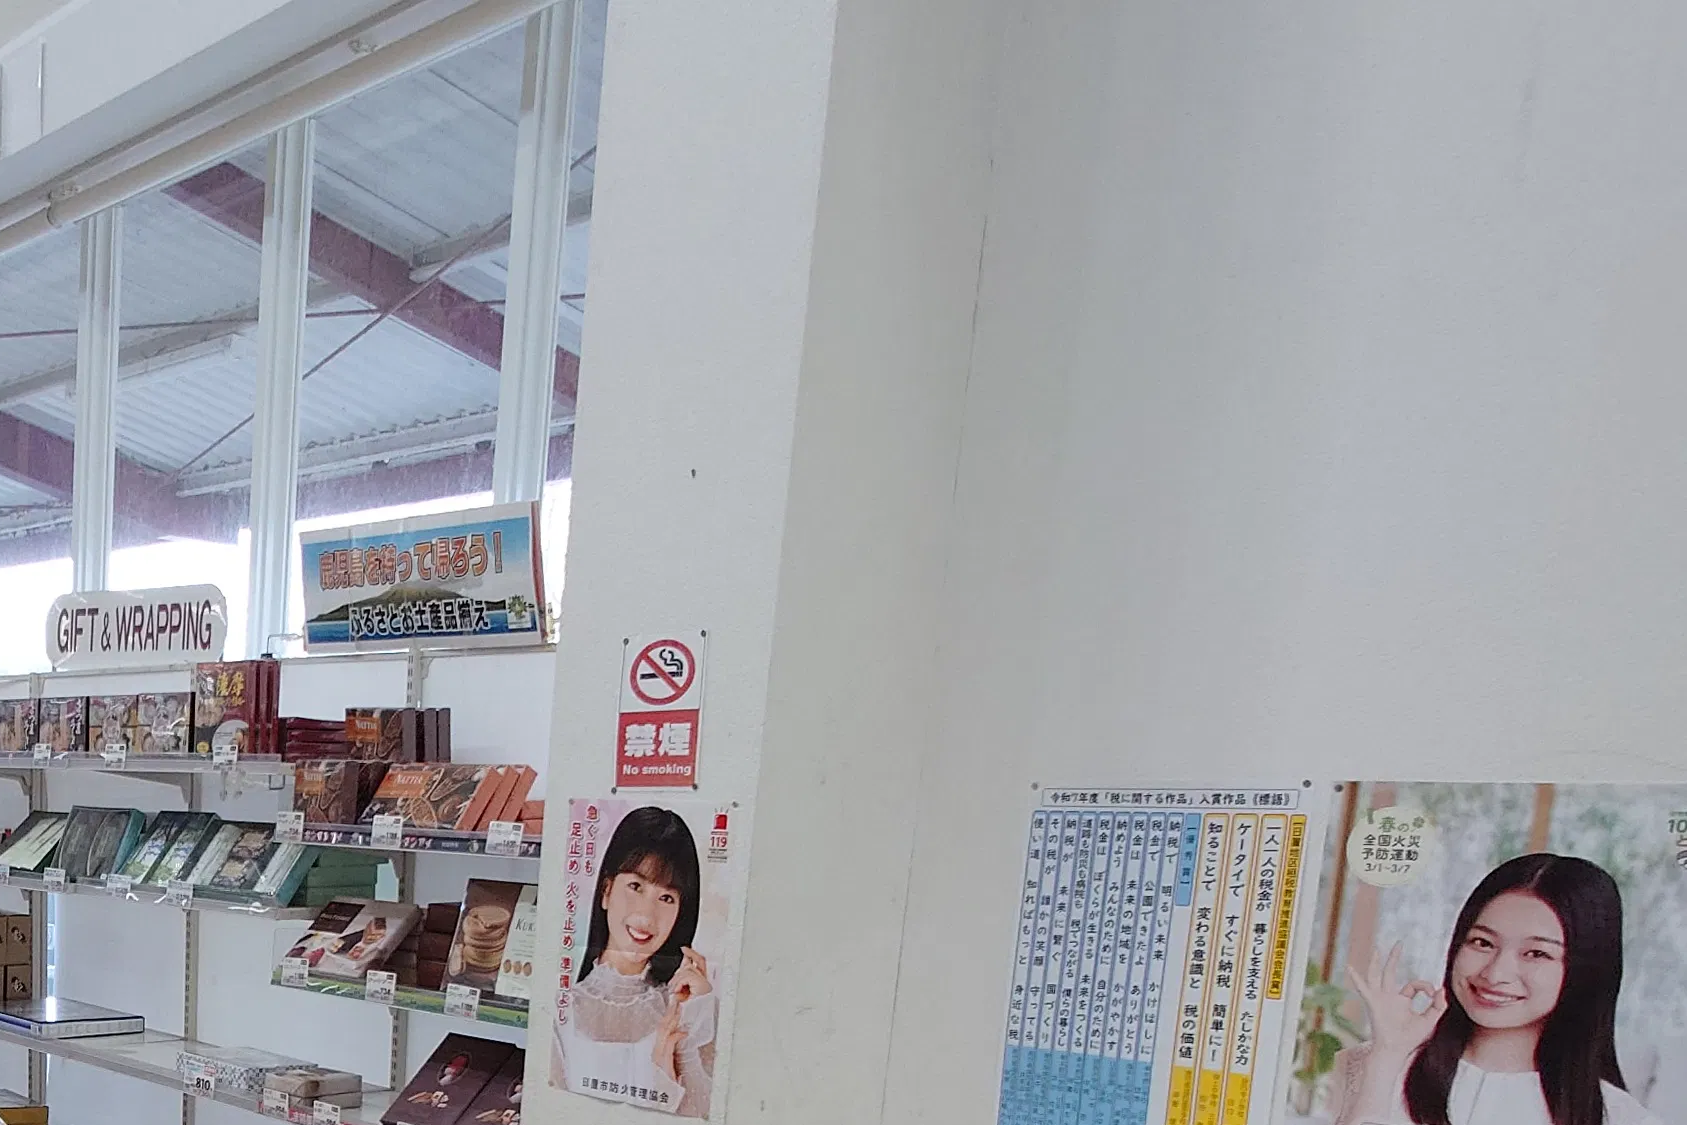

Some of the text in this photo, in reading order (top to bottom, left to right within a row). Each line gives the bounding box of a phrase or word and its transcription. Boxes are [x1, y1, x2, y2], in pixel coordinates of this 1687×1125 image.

[57, 599, 212, 653] GIFT & WRAPPING
[624, 722, 691, 757] 禁煙
[623, 764, 692, 776] No smoking
[585, 805, 599, 875] 急ぐ日も
[711, 836, 727, 847] 119
[1363, 834, 1420, 847] 全国火災
[1379, 817, 1409, 832] 春の
[567, 822, 582, 873] 足止め
[1362, 848, 1418, 861] 予防運動
[1216, 914, 1239, 988] すぐに納税
[1235, 826, 1282, 1065] 一人一人の税金が 暮らしを支える たしかな力
[1178, 1004, 1199, 1058] 税の価値
[196, 1077, 211, 1091] 810
